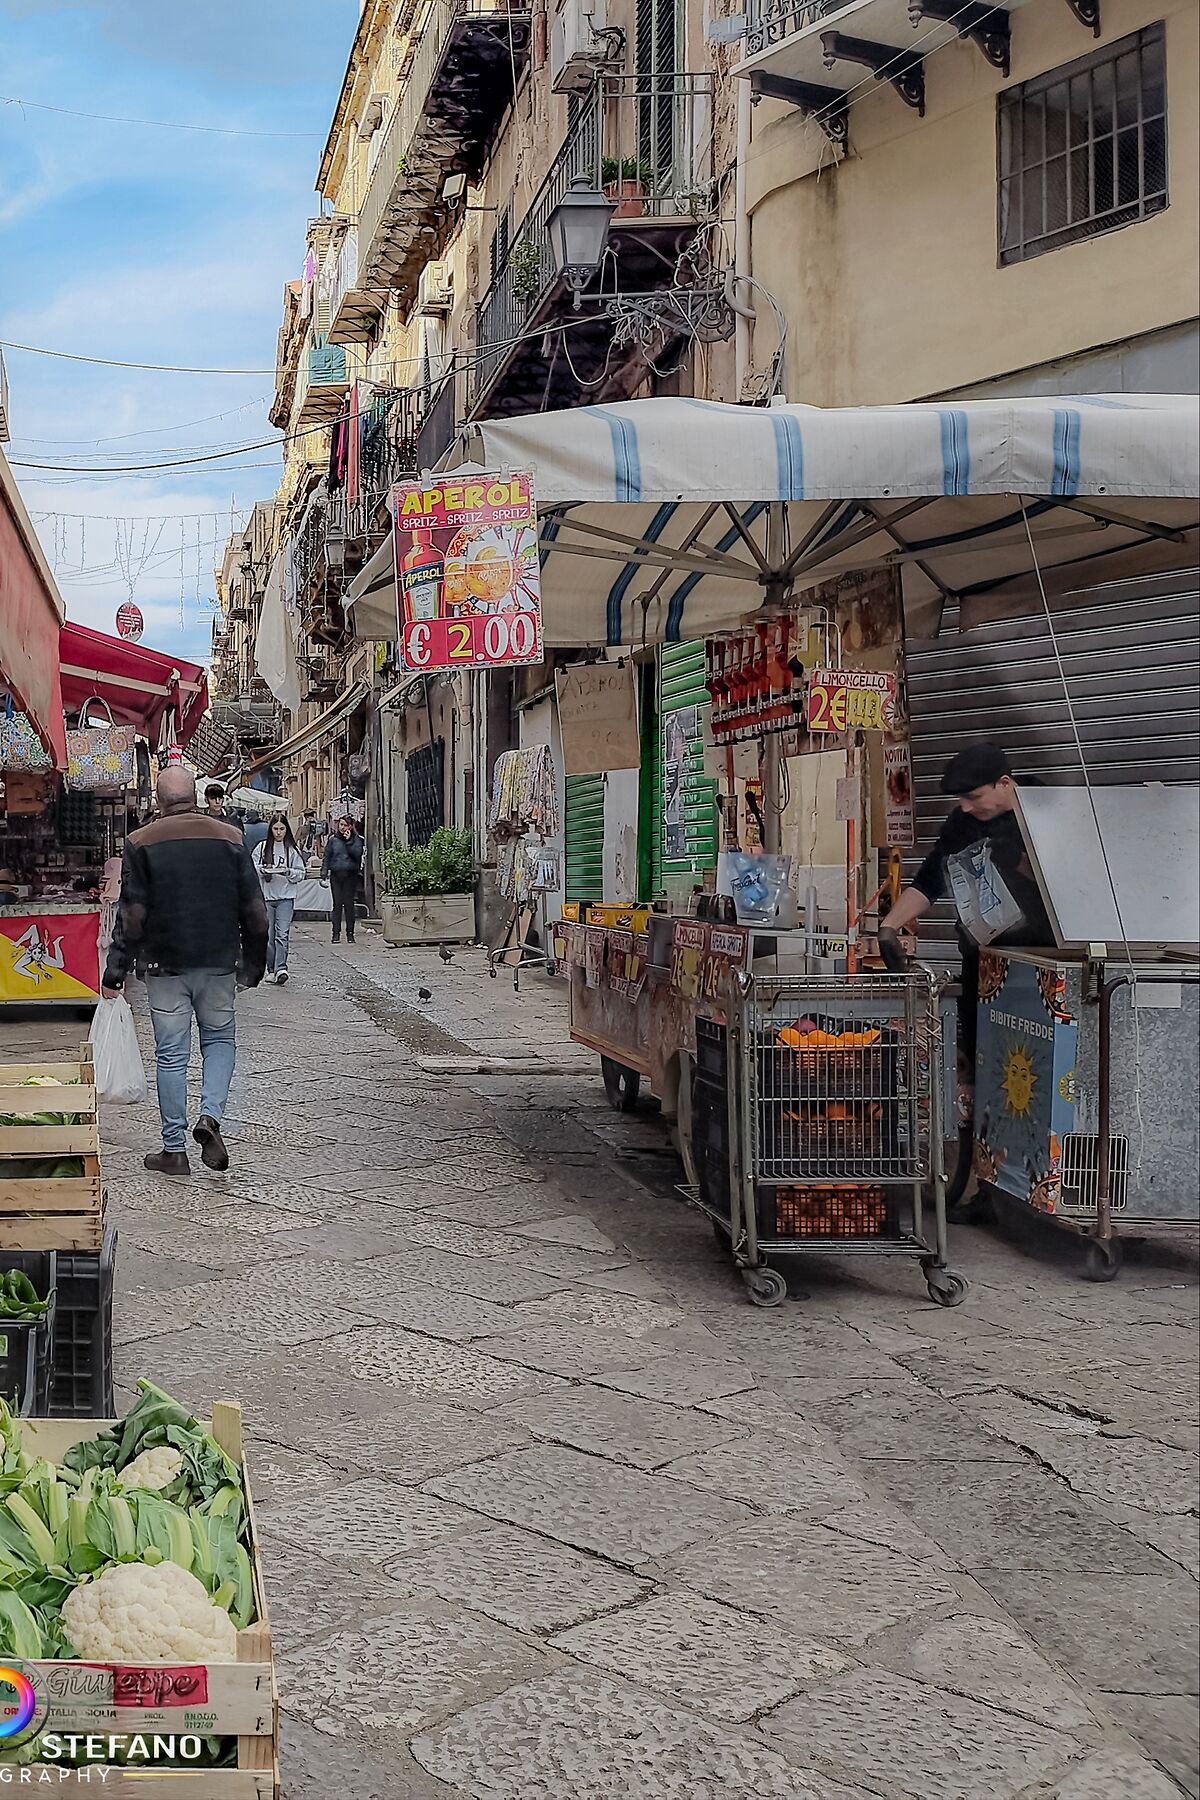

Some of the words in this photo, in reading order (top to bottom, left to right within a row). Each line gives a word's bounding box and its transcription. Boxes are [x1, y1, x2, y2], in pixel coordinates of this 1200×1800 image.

[400, 481, 529, 516] APEROL
[403, 517, 438, 529] SPRITZ
[447, 512, 483, 525] SPRITZ
[492, 507, 529, 521] SPRITZ
[405, 569, 443, 588] APEROL
[406, 623, 432, 665] €
[447, 613, 535, 661] 2.00
[821, 673, 886, 689] LIMONCELLO
[809, 686, 846, 731] 2€
[990, 1008, 1017, 1030] BIBITE
[1018, 1017, 1054, 1042] FREDDE
[49, 1708, 78, 1717] TALIA
